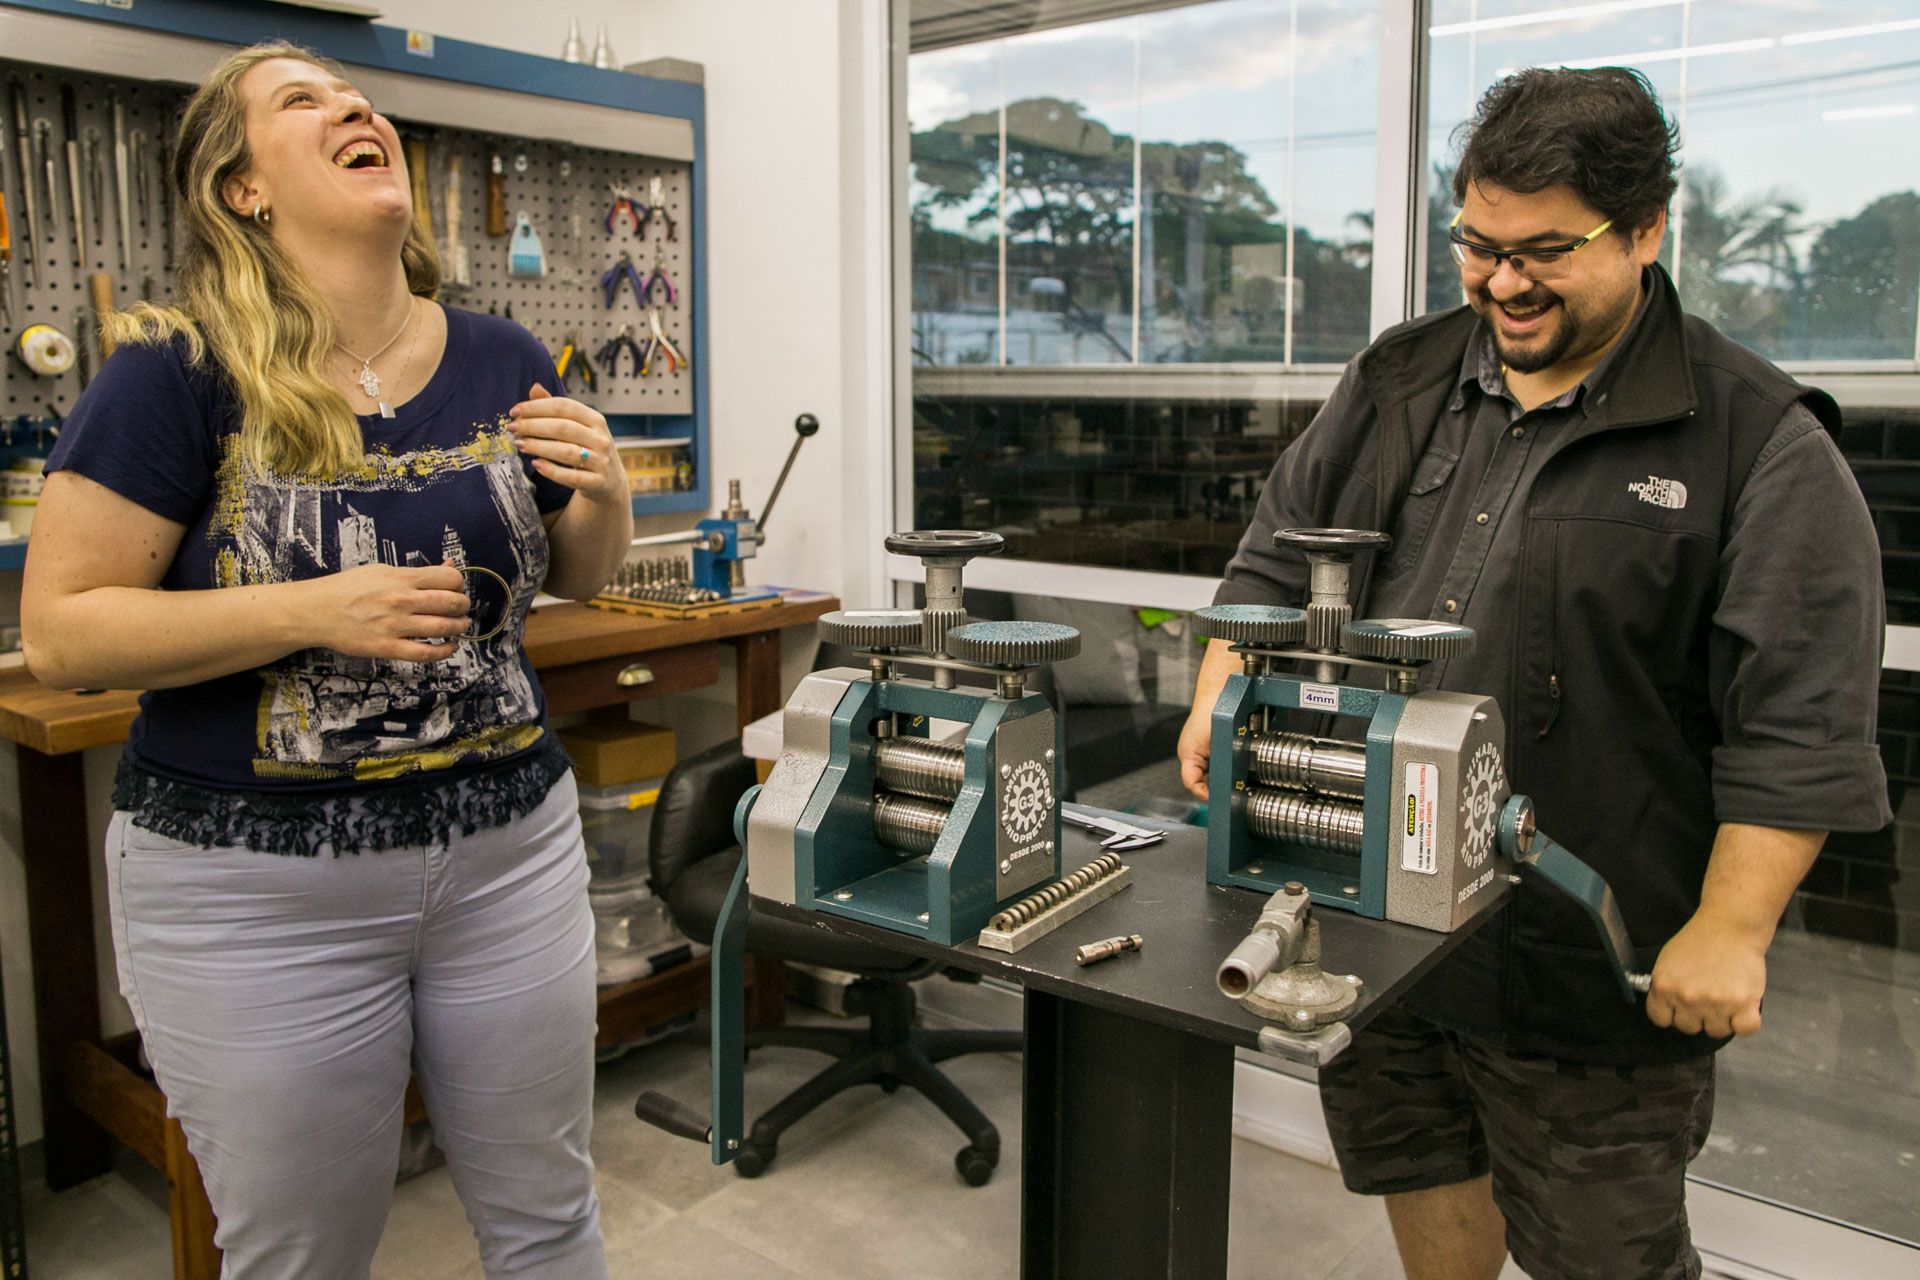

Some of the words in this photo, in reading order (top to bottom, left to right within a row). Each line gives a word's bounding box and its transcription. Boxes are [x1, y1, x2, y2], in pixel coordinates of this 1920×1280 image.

[1628, 482, 1669, 500] NORTH
[1648, 475, 1671, 489] THE
[1639, 493, 1668, 507] FACE
[1306, 693, 1334, 705] 4mm
[1019, 793, 1035, 811] G3
[1474, 791, 1489, 819] G3
[1408, 797, 1416, 834] ATENÇÃO!
[1009, 846, 1030, 861] DESDE
[1030, 840, 1045, 853] 2000
[1458, 878, 1479, 904] DESDE
[1479, 868, 1494, 888] 2000
